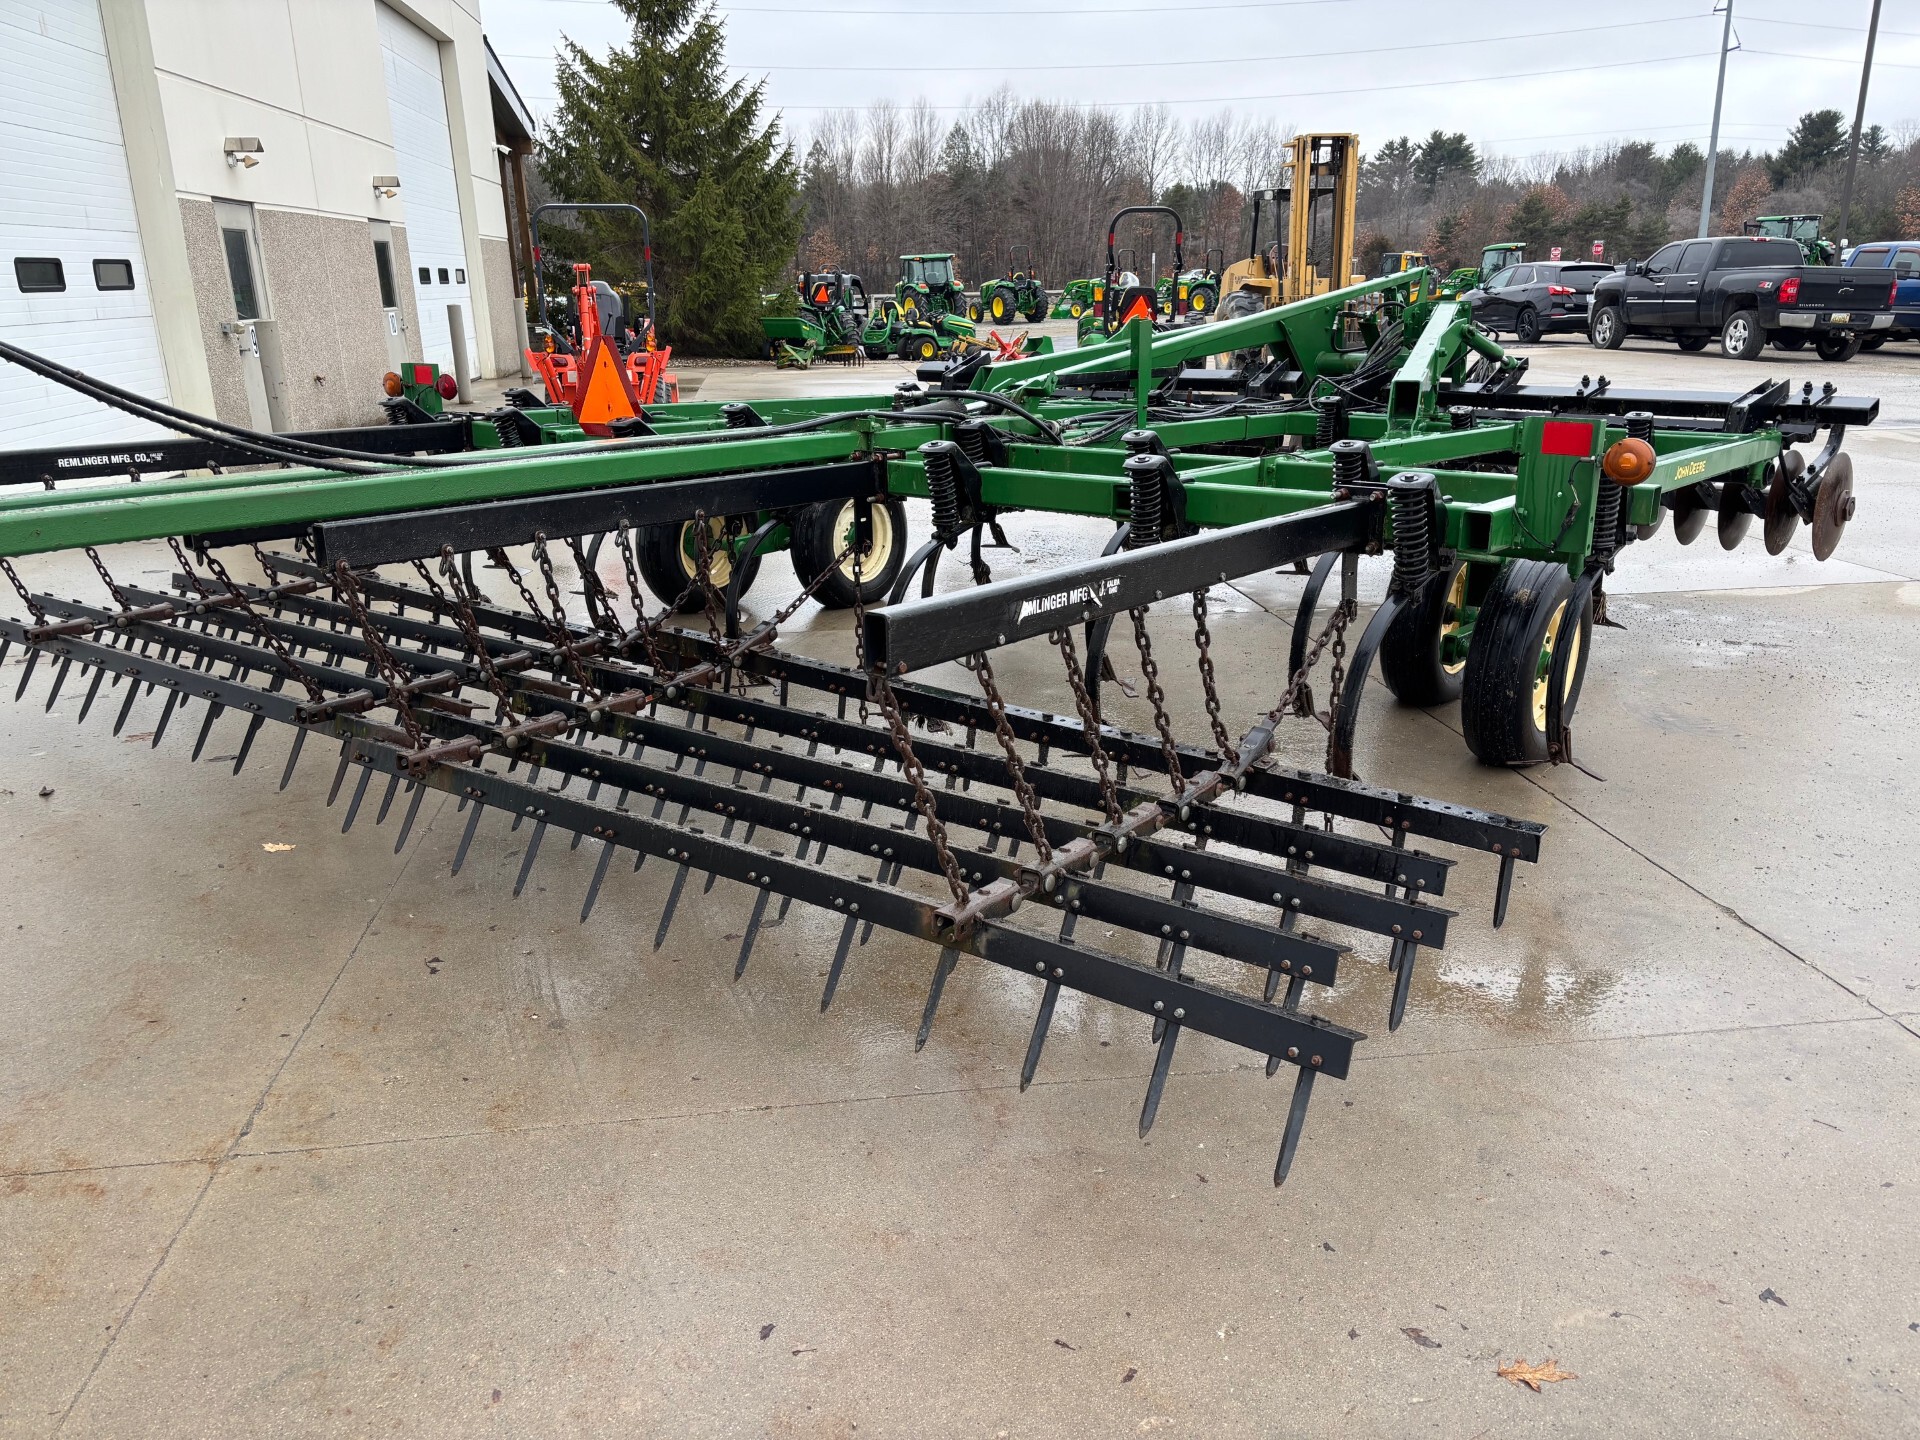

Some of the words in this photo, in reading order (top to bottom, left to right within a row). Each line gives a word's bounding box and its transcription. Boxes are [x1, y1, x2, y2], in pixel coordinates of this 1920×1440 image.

[58, 456, 110, 468] REMLINGER
[111, 454, 133, 463] MFG.
[1674, 464, 1690, 480] JOHN
[1690, 460, 1707, 476] DEERE
[1021, 592, 1068, 616] MLINGER
